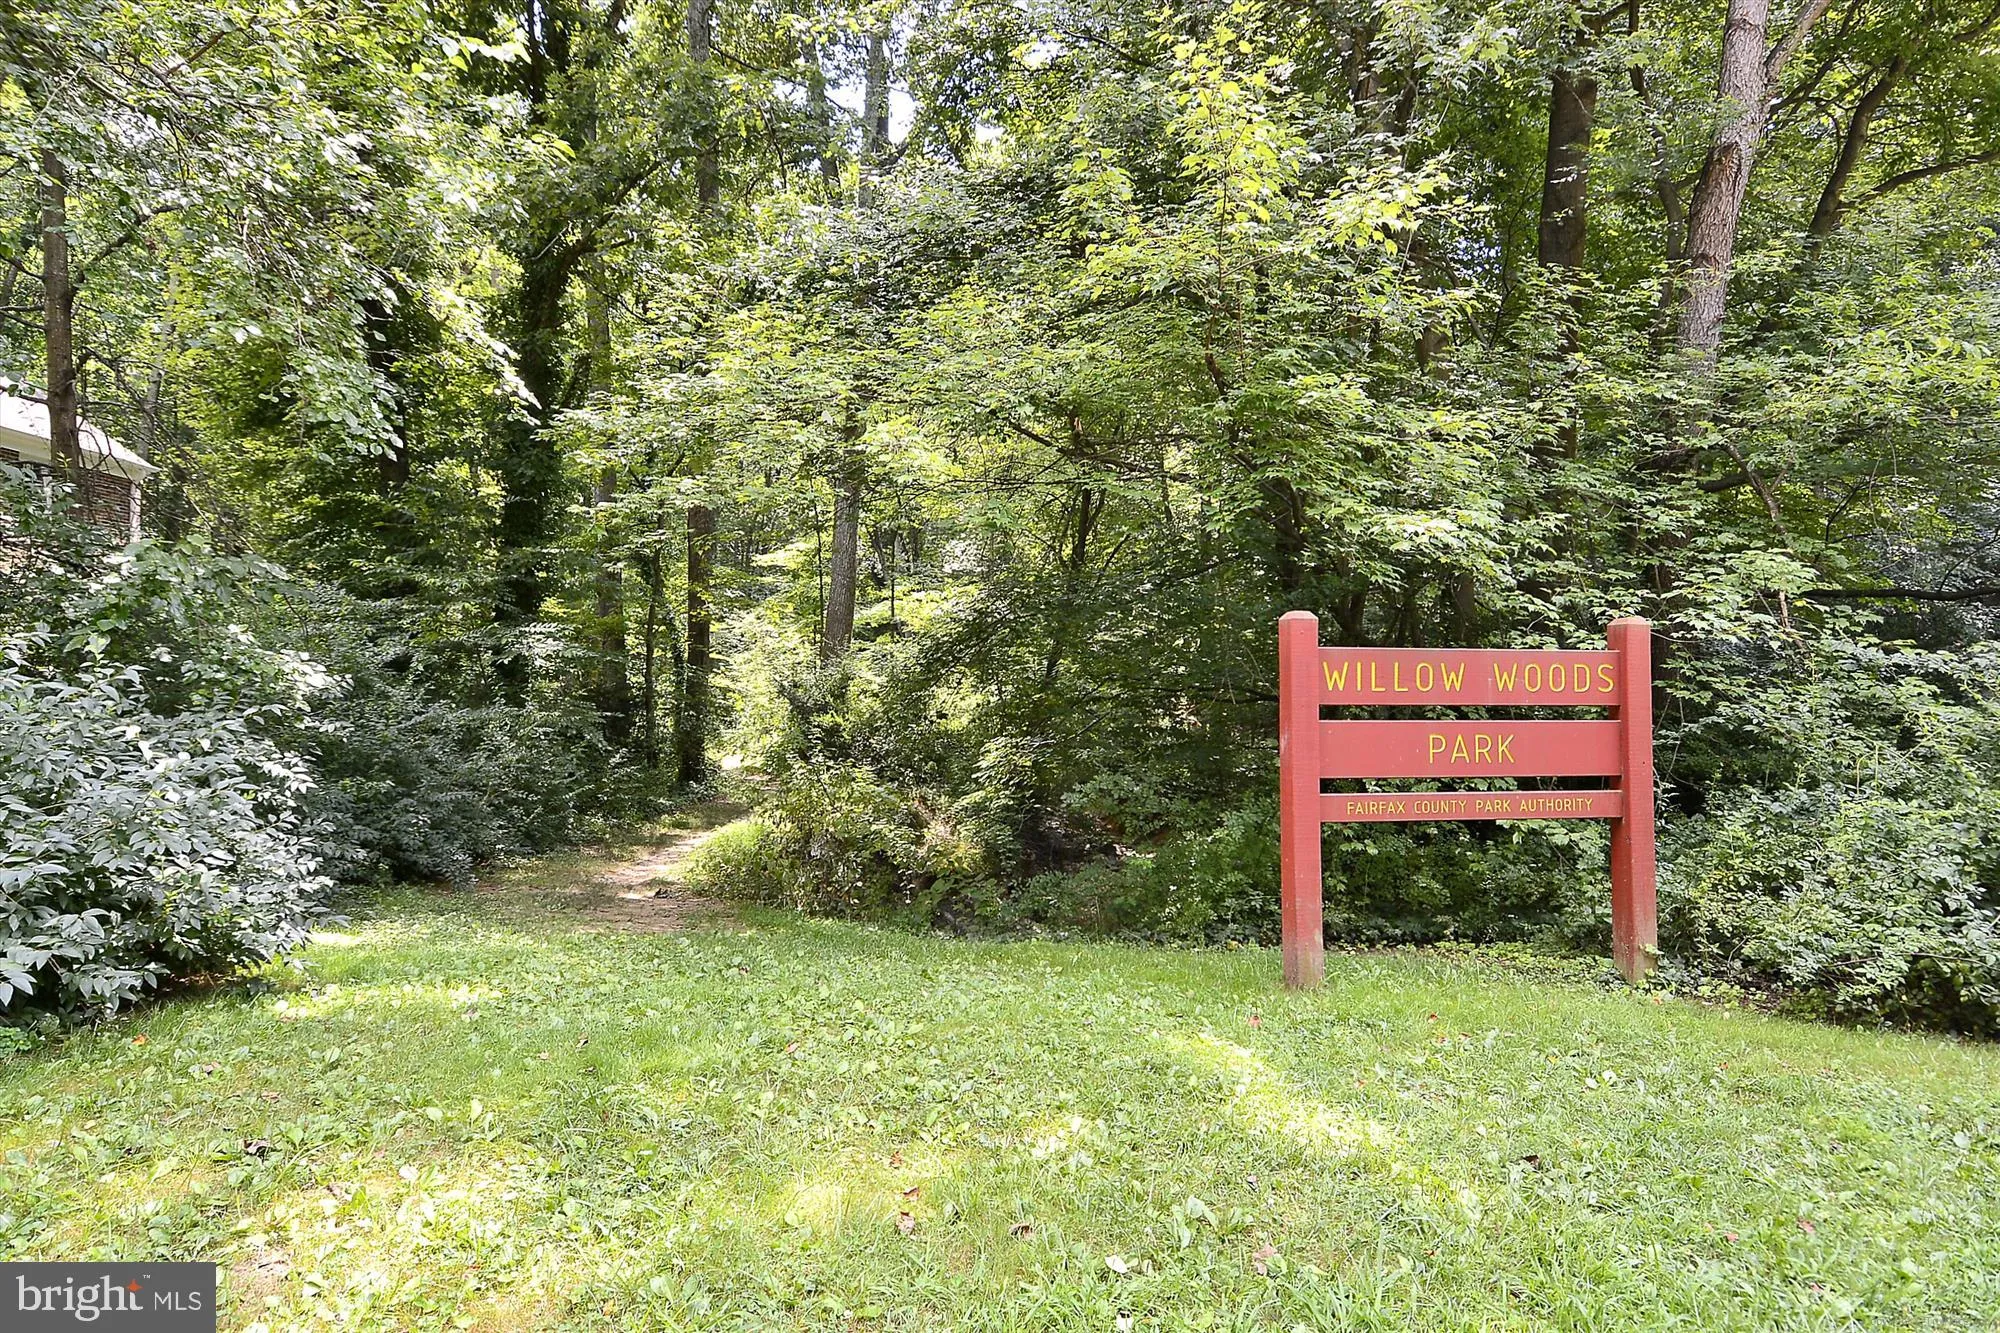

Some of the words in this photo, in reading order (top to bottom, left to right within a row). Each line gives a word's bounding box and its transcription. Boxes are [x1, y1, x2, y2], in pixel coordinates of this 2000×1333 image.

[1323, 660, 1466, 692] WILLOW
[1494, 662, 1615, 693] WOODS
[1429, 734, 1516, 763] PARK
[1346, 801, 1406, 815] FAIRFAX
[1414, 800, 1467, 814] COUNTY
[1475, 799, 1511, 813] PARK
[1519, 798, 1593, 812] AUTHORITY
